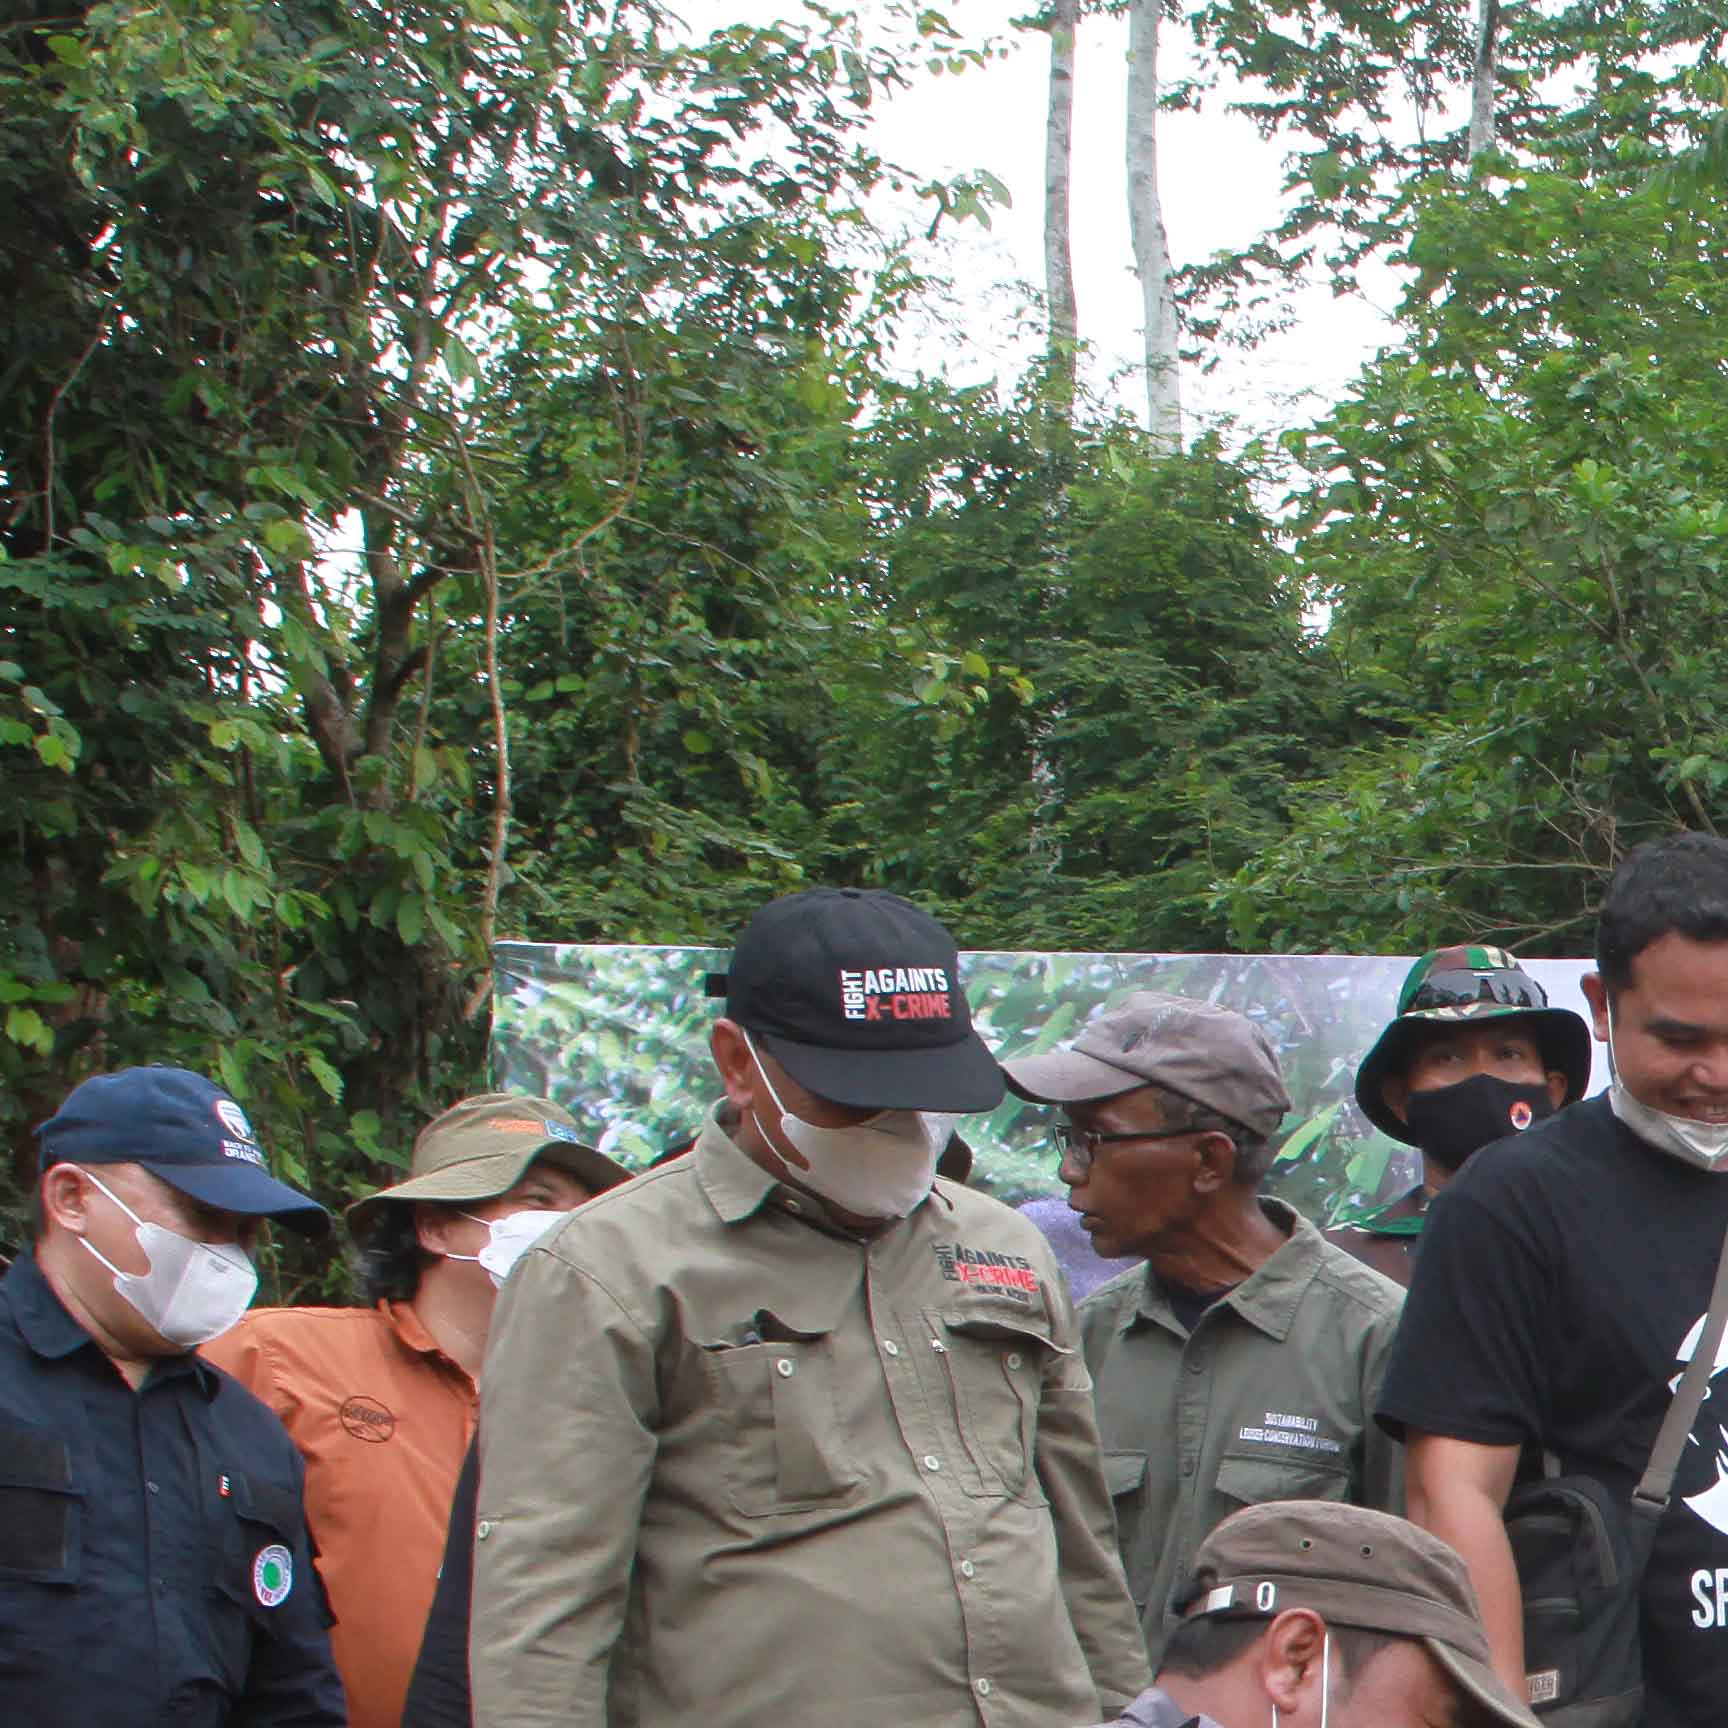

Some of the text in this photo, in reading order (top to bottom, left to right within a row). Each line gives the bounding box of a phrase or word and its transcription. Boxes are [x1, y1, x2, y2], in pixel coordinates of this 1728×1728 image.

[841, 969, 866, 1019] FIGHT
[864, 967, 949, 994] AGAINTS
[866, 993, 951, 1020] X-CRIME
